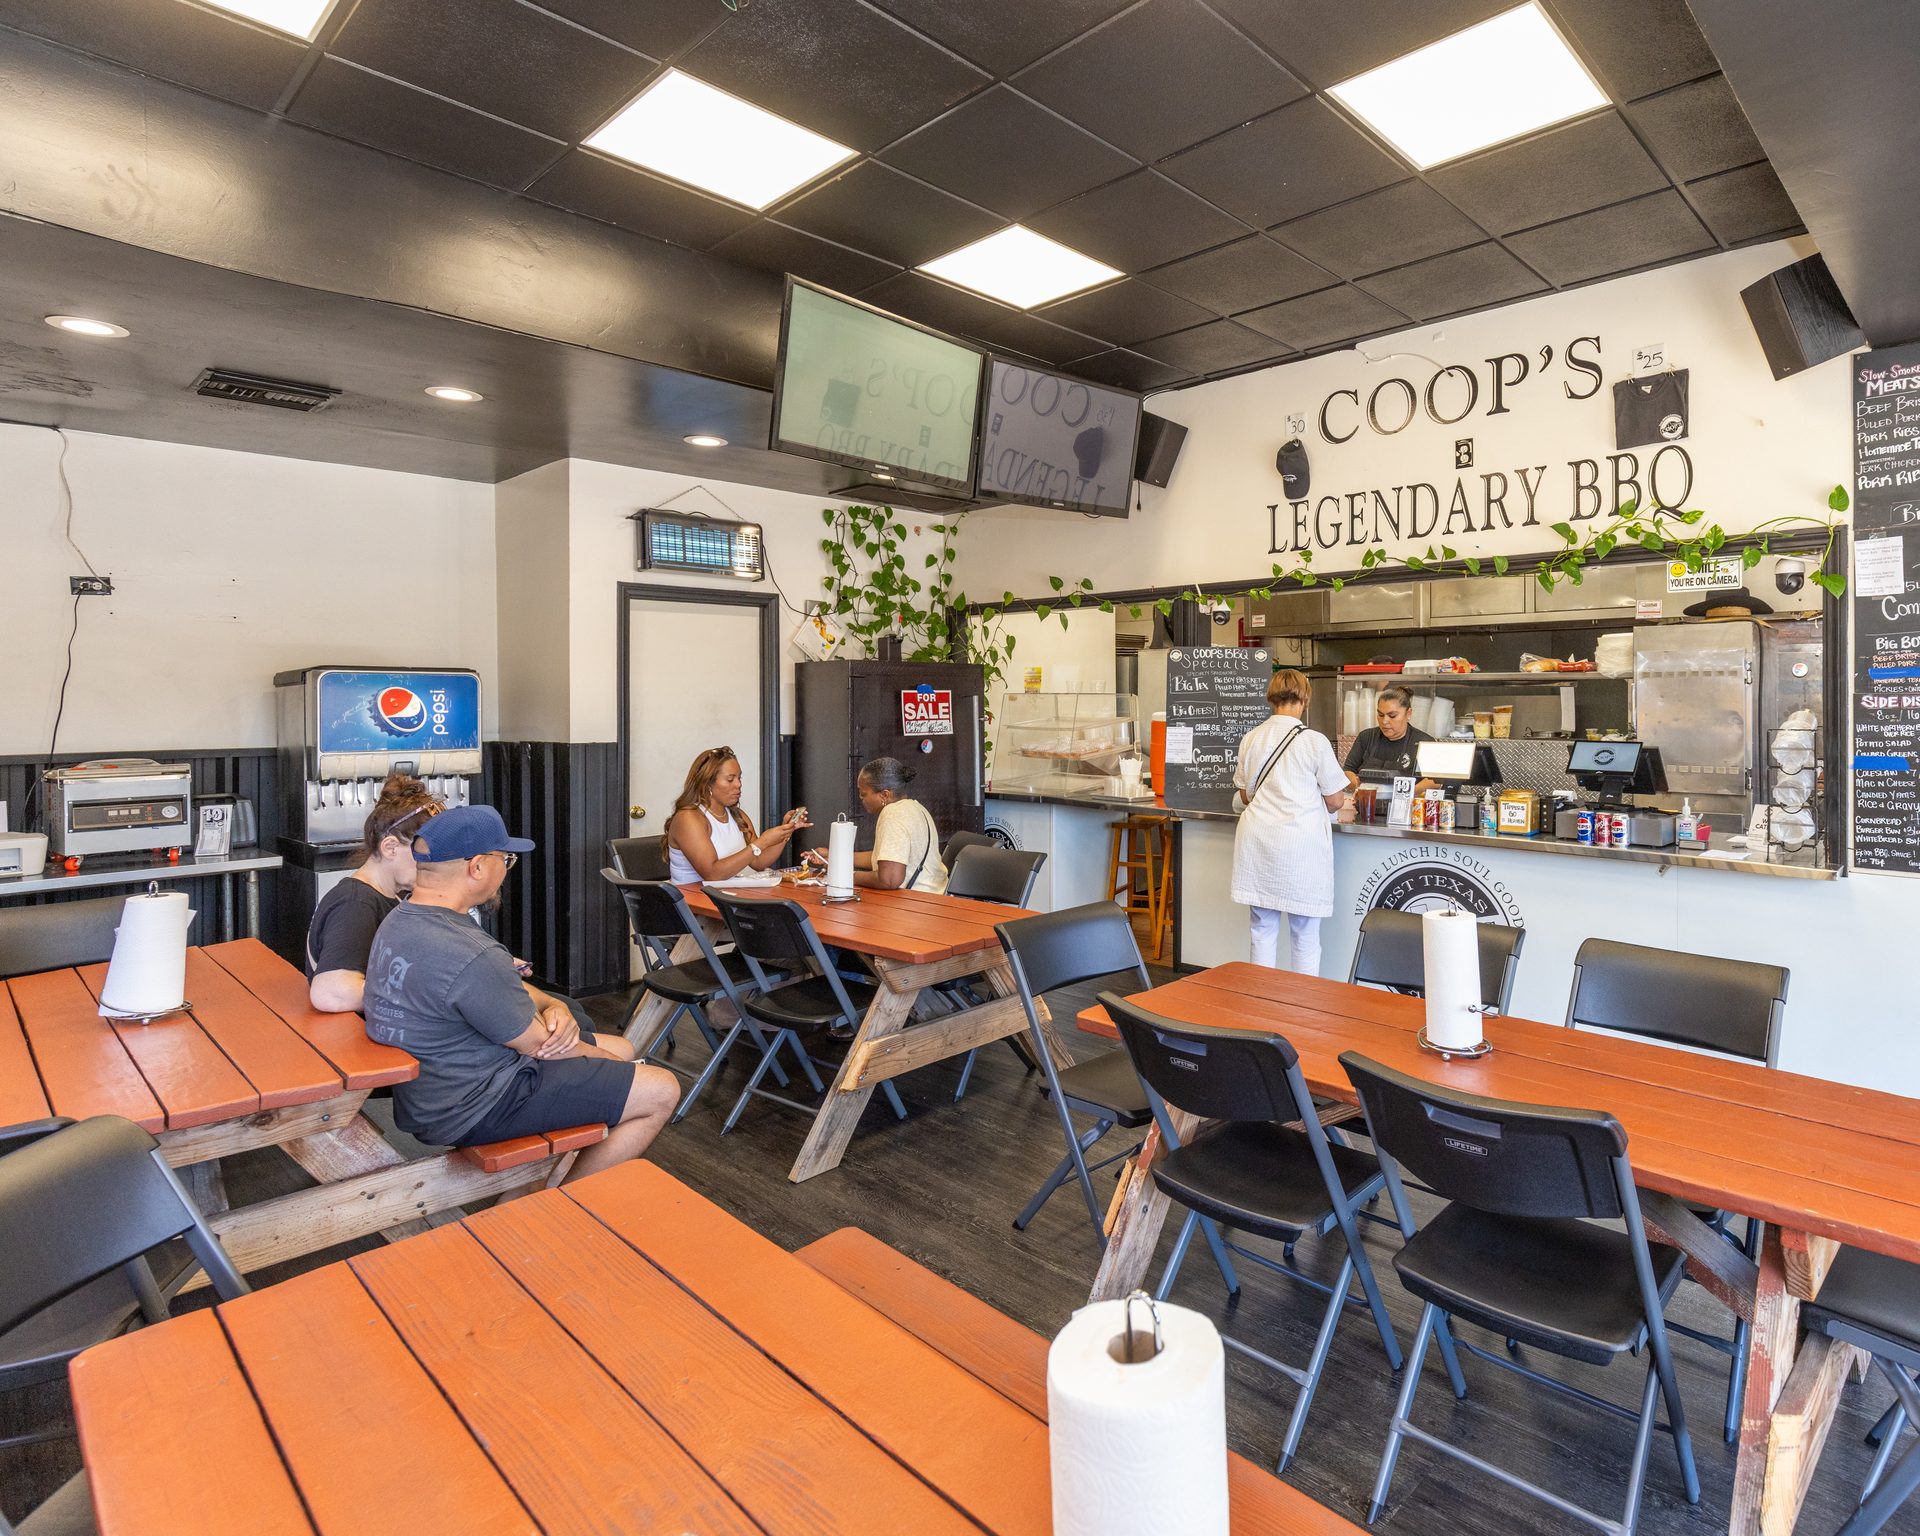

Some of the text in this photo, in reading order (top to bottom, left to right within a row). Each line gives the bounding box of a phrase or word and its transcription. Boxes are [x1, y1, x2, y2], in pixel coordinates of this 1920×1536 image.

[1637, 352, 1664, 369] $25
[1318, 336, 1603, 445] COOP'S
[1856, 401, 1892, 417] BEEF
[1287, 415, 1305, 434] $30
[1857, 418, 1892, 431] PULLED
[1857, 432, 1888, 446] PORK
[1856, 463, 1883, 475] JERK
[1858, 475, 1892, 491] PORK
[1267, 445, 1694, 555] LEGENDARY BBQ
[1670, 575, 1738, 588] YOU'RE ON CAMERA
[1193, 648, 1249, 660] COOP'S BBQ
[1181, 654, 1249, 671] Specials
[917, 693, 936, 702] FOR
[1861, 695, 1899, 709] SIDE
[429, 688, 448, 735] pepsi
[904, 702, 950, 720] SALE
[1856, 724, 1879, 733] WHITE
[1886, 740, 1912, 748] SALAD
[1856, 779, 1876, 788] MAC
[1355, 846, 1525, 928] WHERE LUNCH IS SOUL GOOD
[1419, 874, 1488, 914] TEXAS
